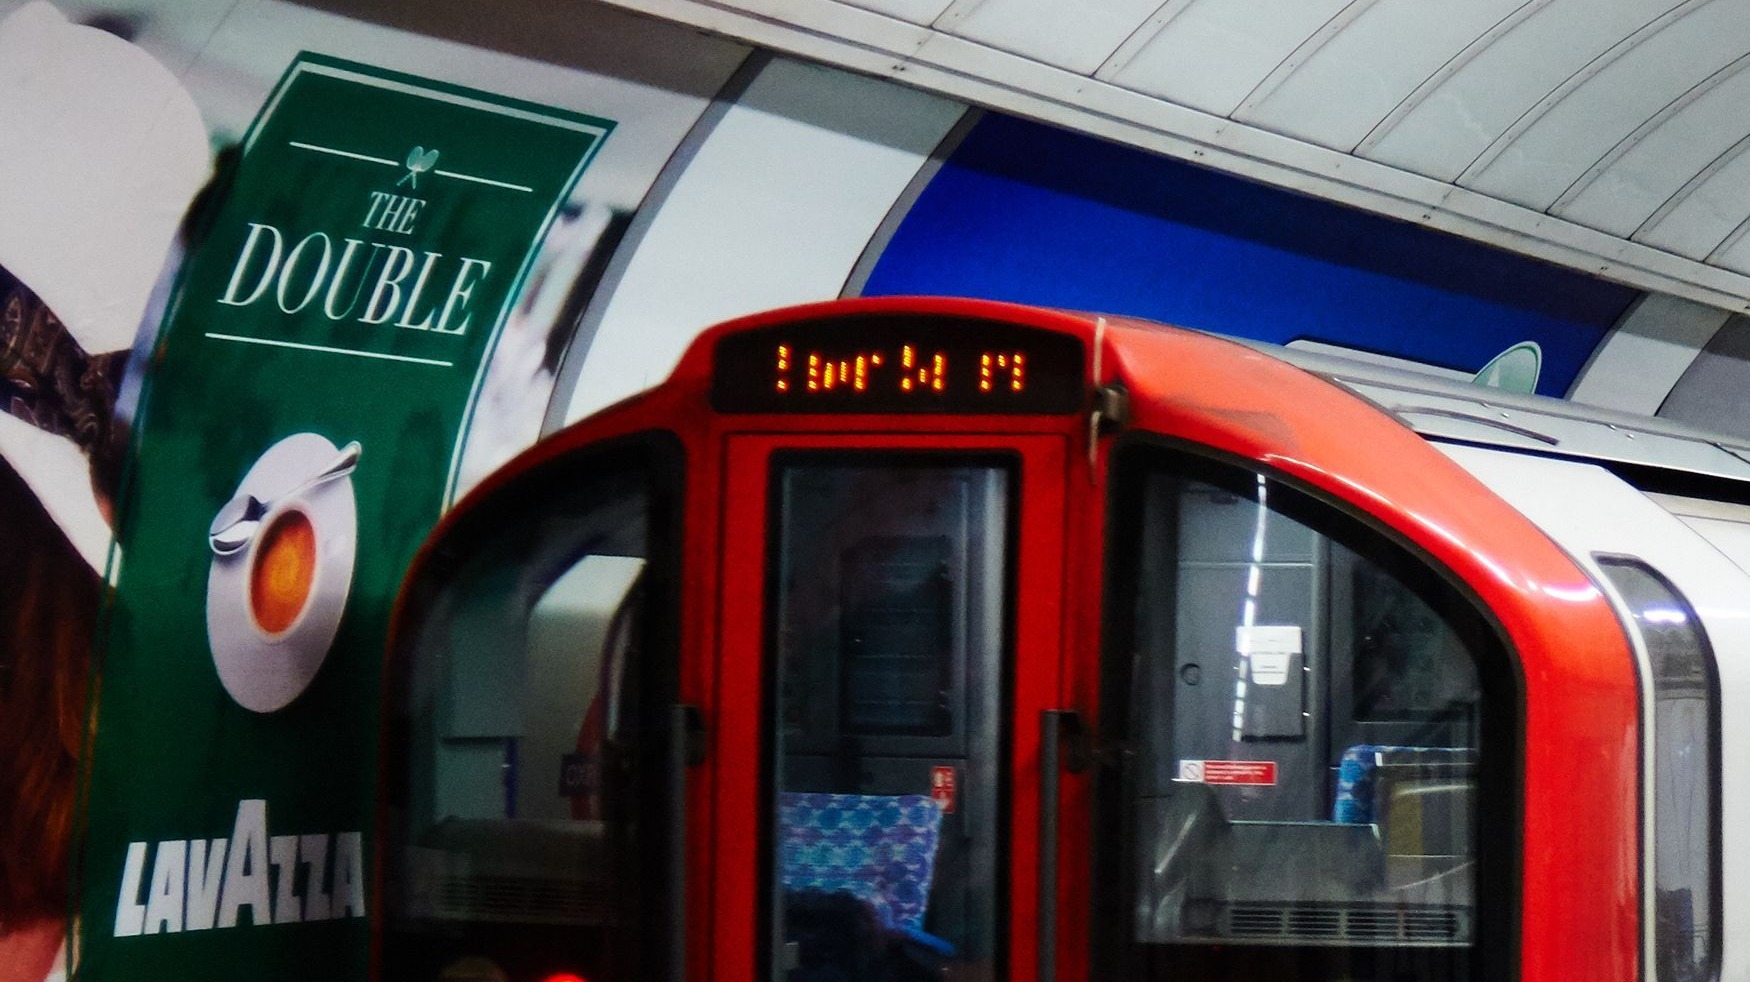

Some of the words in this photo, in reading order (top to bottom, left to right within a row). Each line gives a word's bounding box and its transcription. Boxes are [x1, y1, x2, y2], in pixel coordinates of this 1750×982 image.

[362, 190, 427, 235] THE
[216, 222, 492, 336] DOUBLE
[113, 799, 365, 938] LAVAZZA
